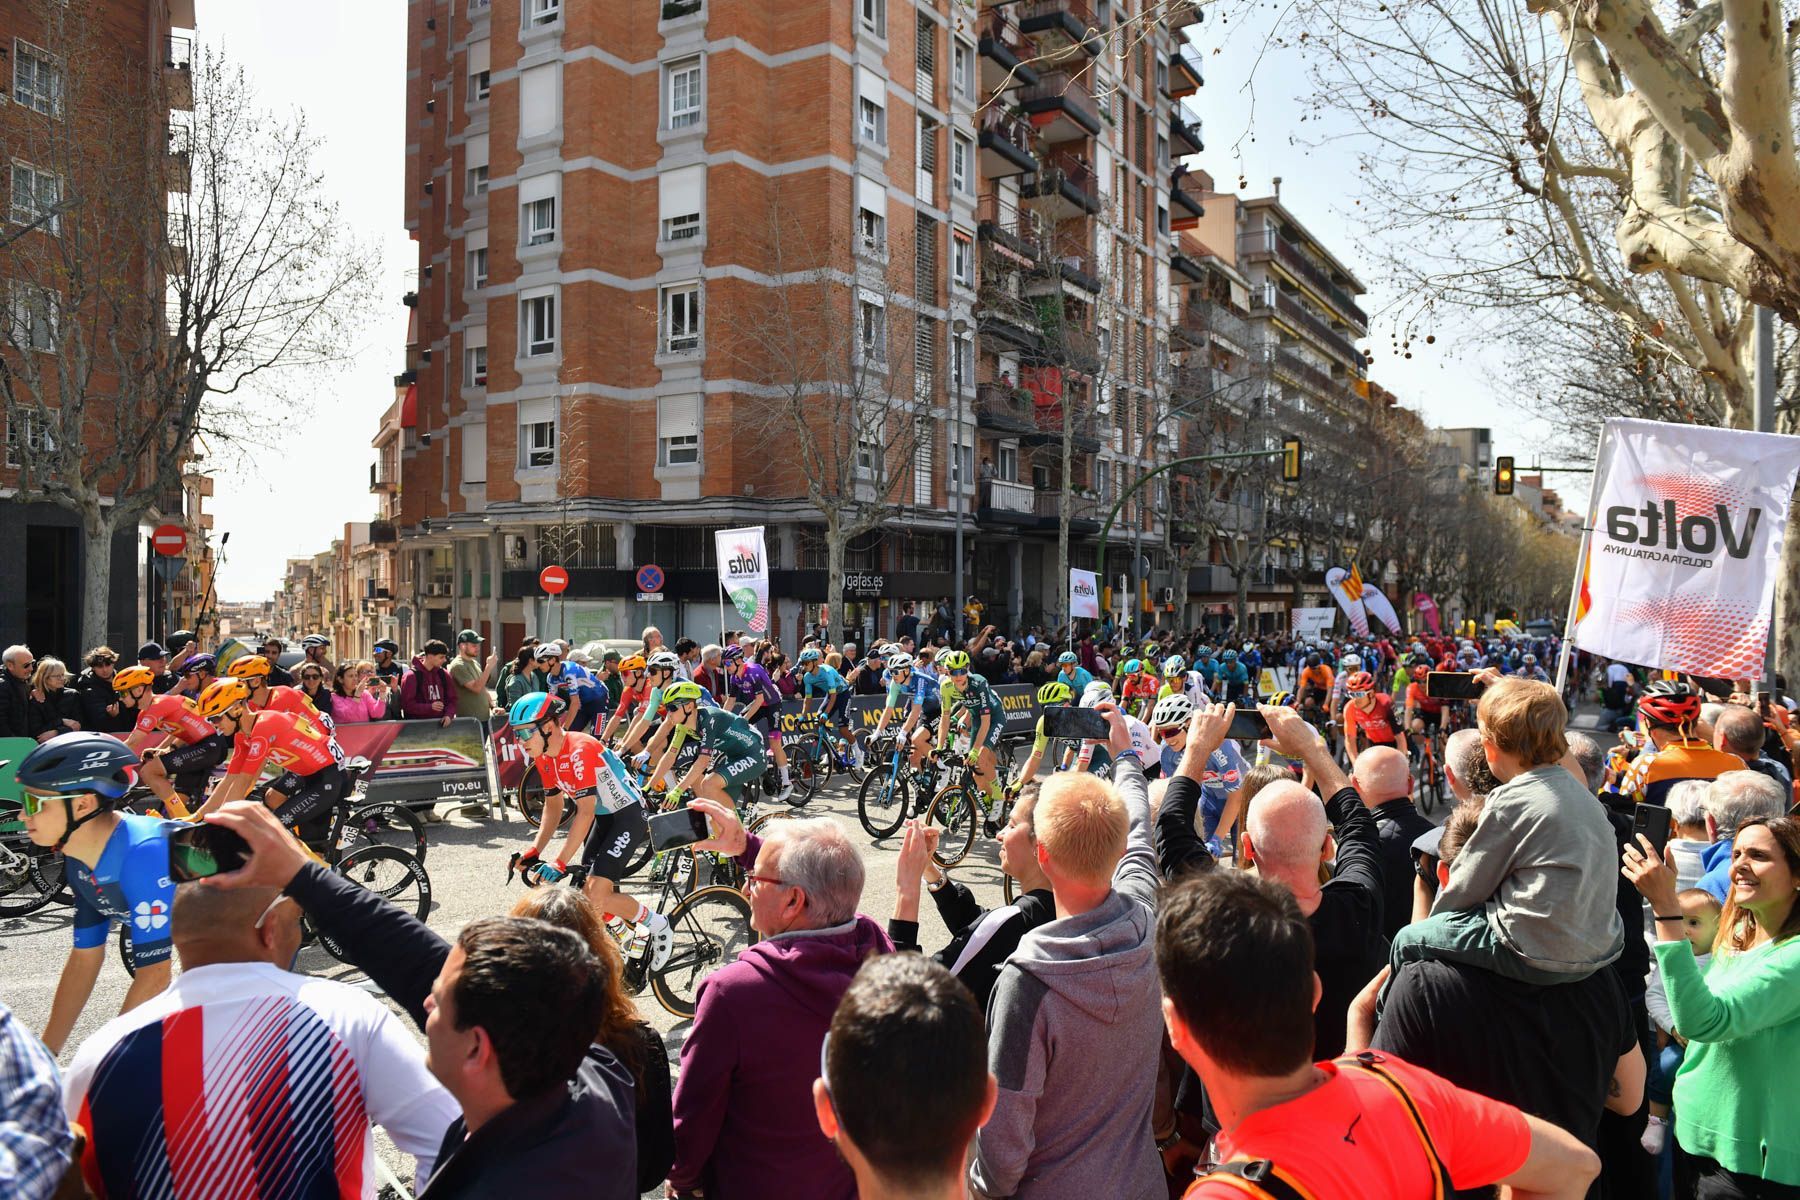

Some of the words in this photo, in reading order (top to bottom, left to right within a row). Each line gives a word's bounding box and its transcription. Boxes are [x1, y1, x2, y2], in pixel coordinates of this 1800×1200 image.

[847, 572, 884, 590] gafas.es
[1003, 695, 1033, 710] ORITZ
[1006, 711, 1032, 721] ARCELONA
[990, 723, 1004, 745] BORA
[570, 749, 584, 780] lotto
[727, 756, 758, 776] BORA
[1095, 763, 1110, 777] ORA
[442, 781, 481, 794] iryo.eu
[606, 777, 621, 800] SOLAR
[291, 791, 320, 815] REITAN
[361, 807, 382, 819] SWISS
[344, 827, 359, 844] 205
[607, 831, 630, 858] lotto
[31, 857, 38, 870] DT
[408, 860, 425, 882] SWISS
[680, 858, 693, 875] 184
[33, 870, 50, 891] SWISS
[420, 881, 428, 894] DT
